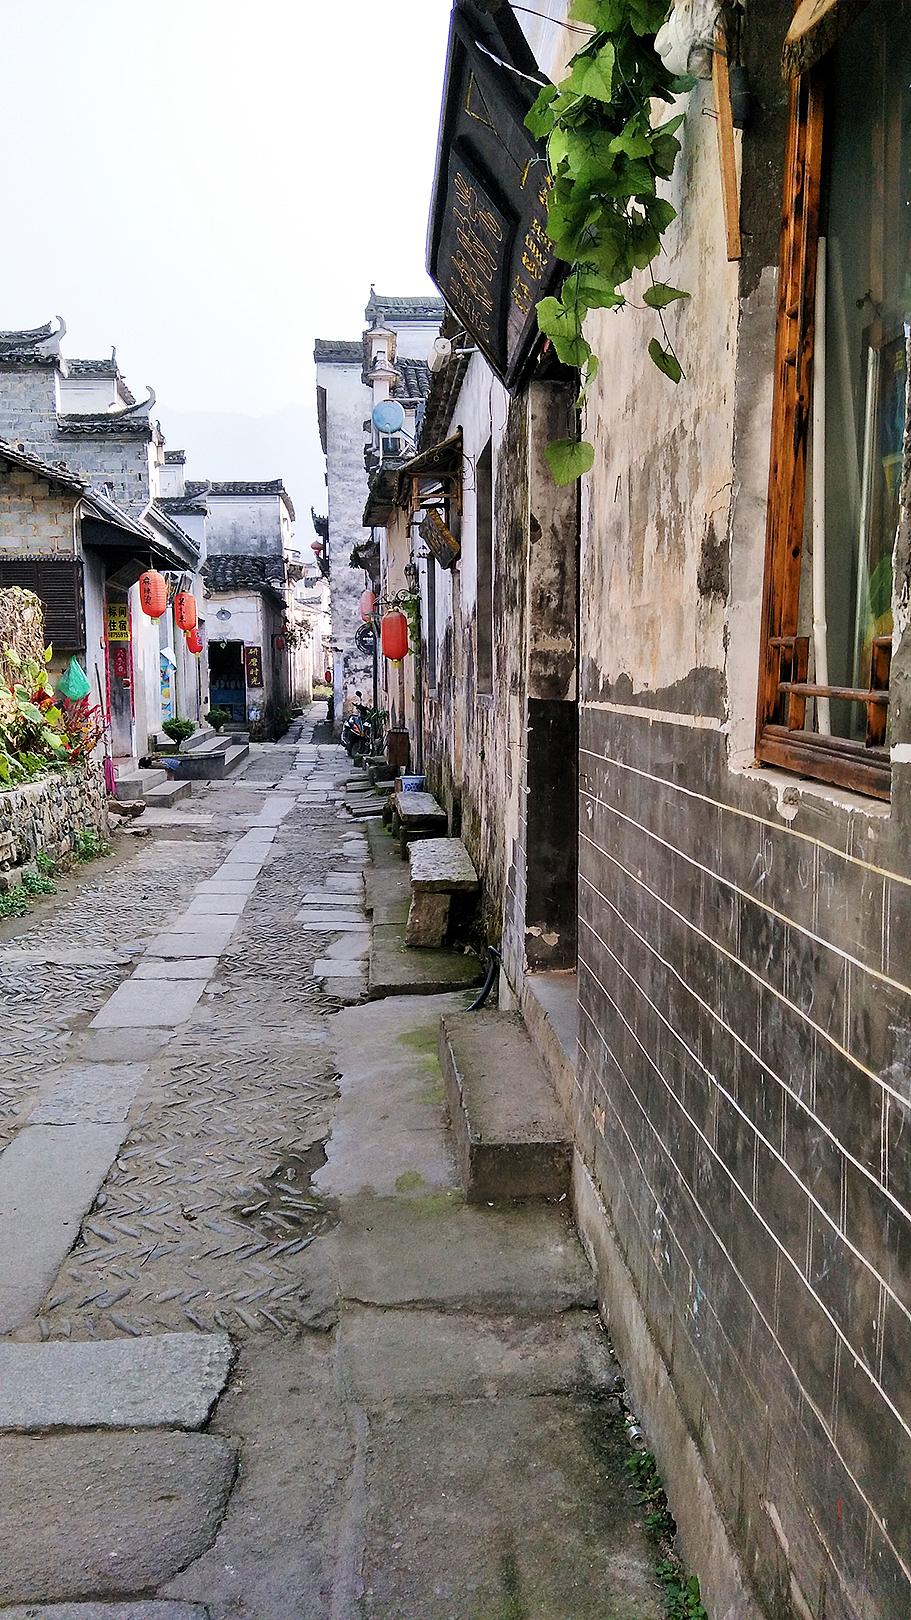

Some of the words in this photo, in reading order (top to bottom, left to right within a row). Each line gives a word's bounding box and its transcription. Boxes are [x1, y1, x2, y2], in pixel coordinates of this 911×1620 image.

[108, 606, 127, 617] 标间
[108, 619, 128, 632] 住宿
[247, 647, 261, 686] 研磨时光
